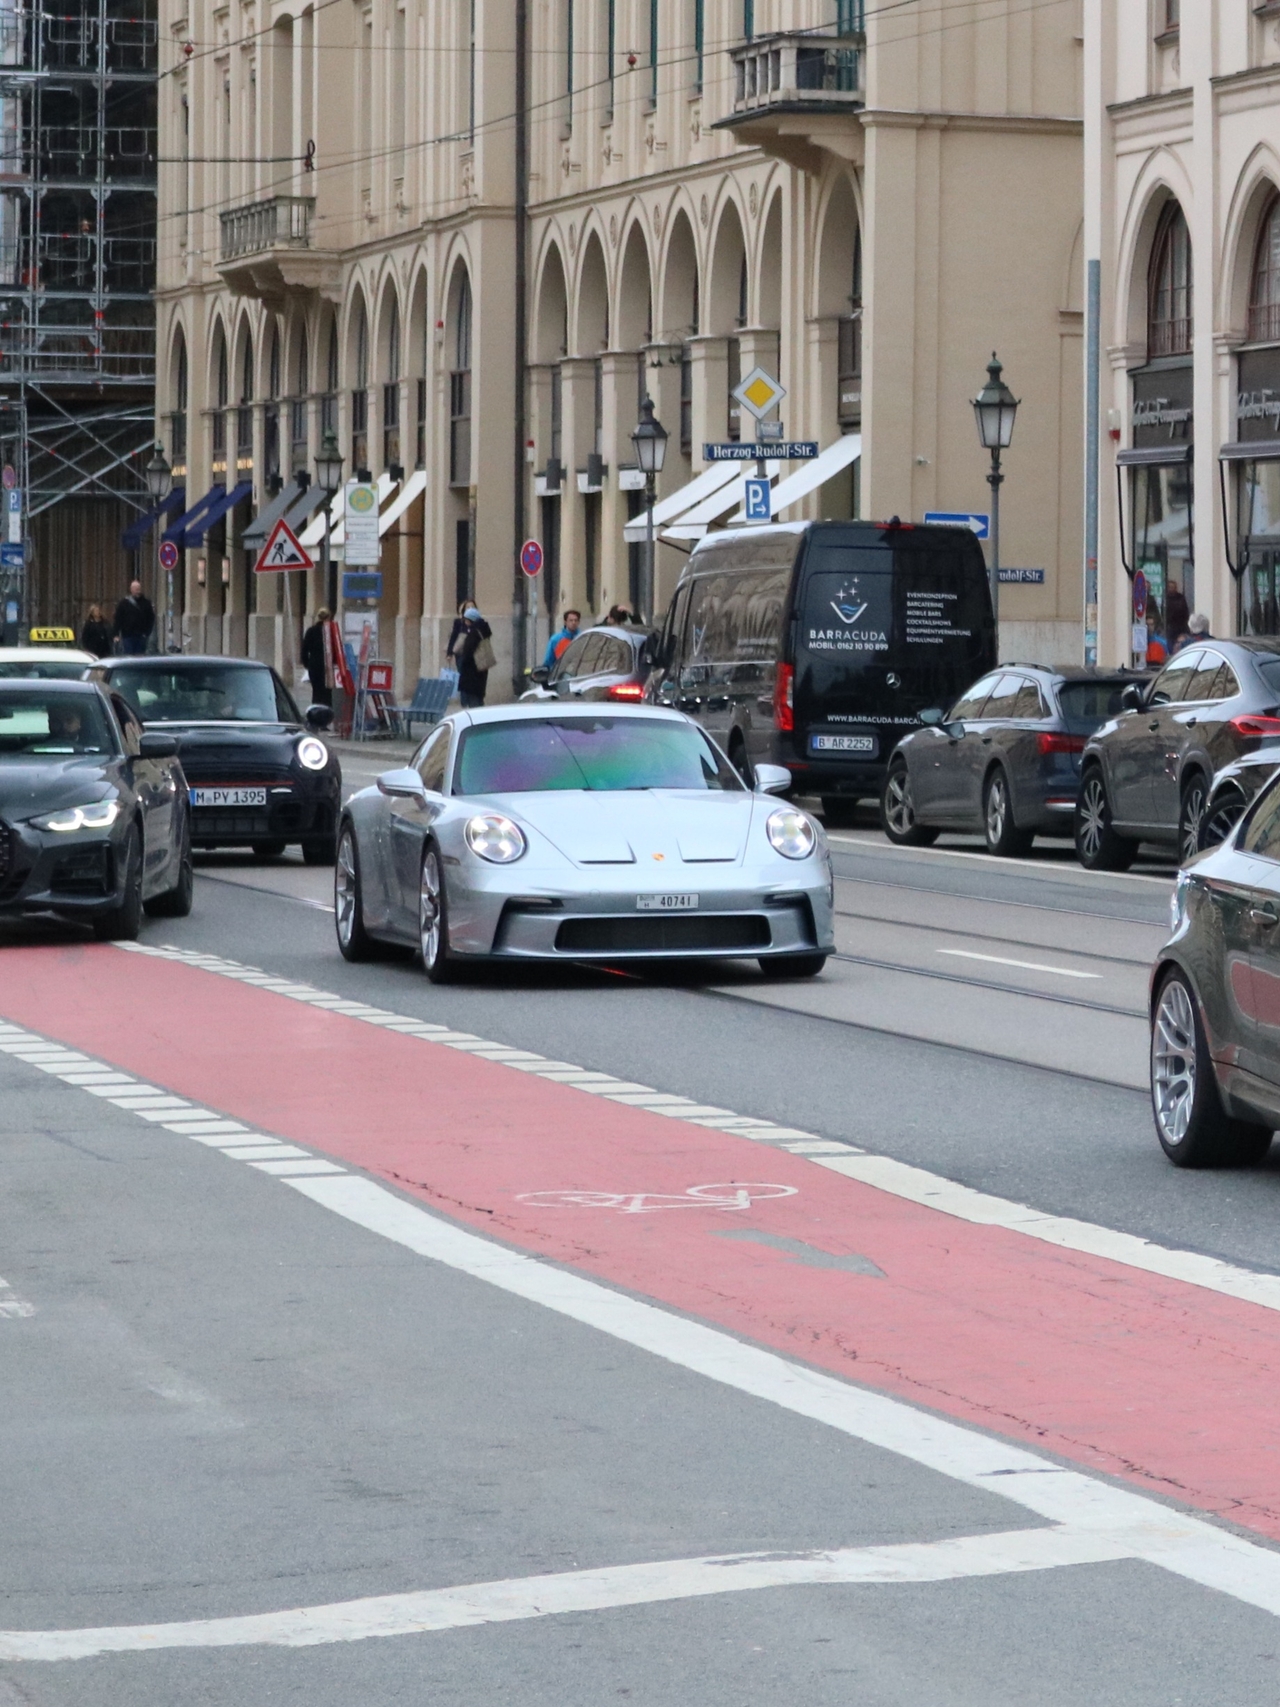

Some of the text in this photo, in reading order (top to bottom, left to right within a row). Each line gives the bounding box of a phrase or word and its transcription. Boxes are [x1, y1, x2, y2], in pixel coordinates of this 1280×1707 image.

[713, 444, 813, 459] Herzog-Rudolf-Str.
[749, 484, 763, 515] P
[906, 592, 958, 600] EVENTKONZEPTION
[906, 601, 944, 609] BARCATERING
[906, 618, 952, 626] COCKTAILSHOWS
[37, 629, 69, 640] TAXI
[809, 629, 886, 641] BARRACUDA
[808, 642, 889, 651] MOBIL: 0162 10 90 899
[818, 738, 872, 750] B AR 2252
[196, 791, 265, 804] M PY 1395
[660, 895, 691, 907] 40741
